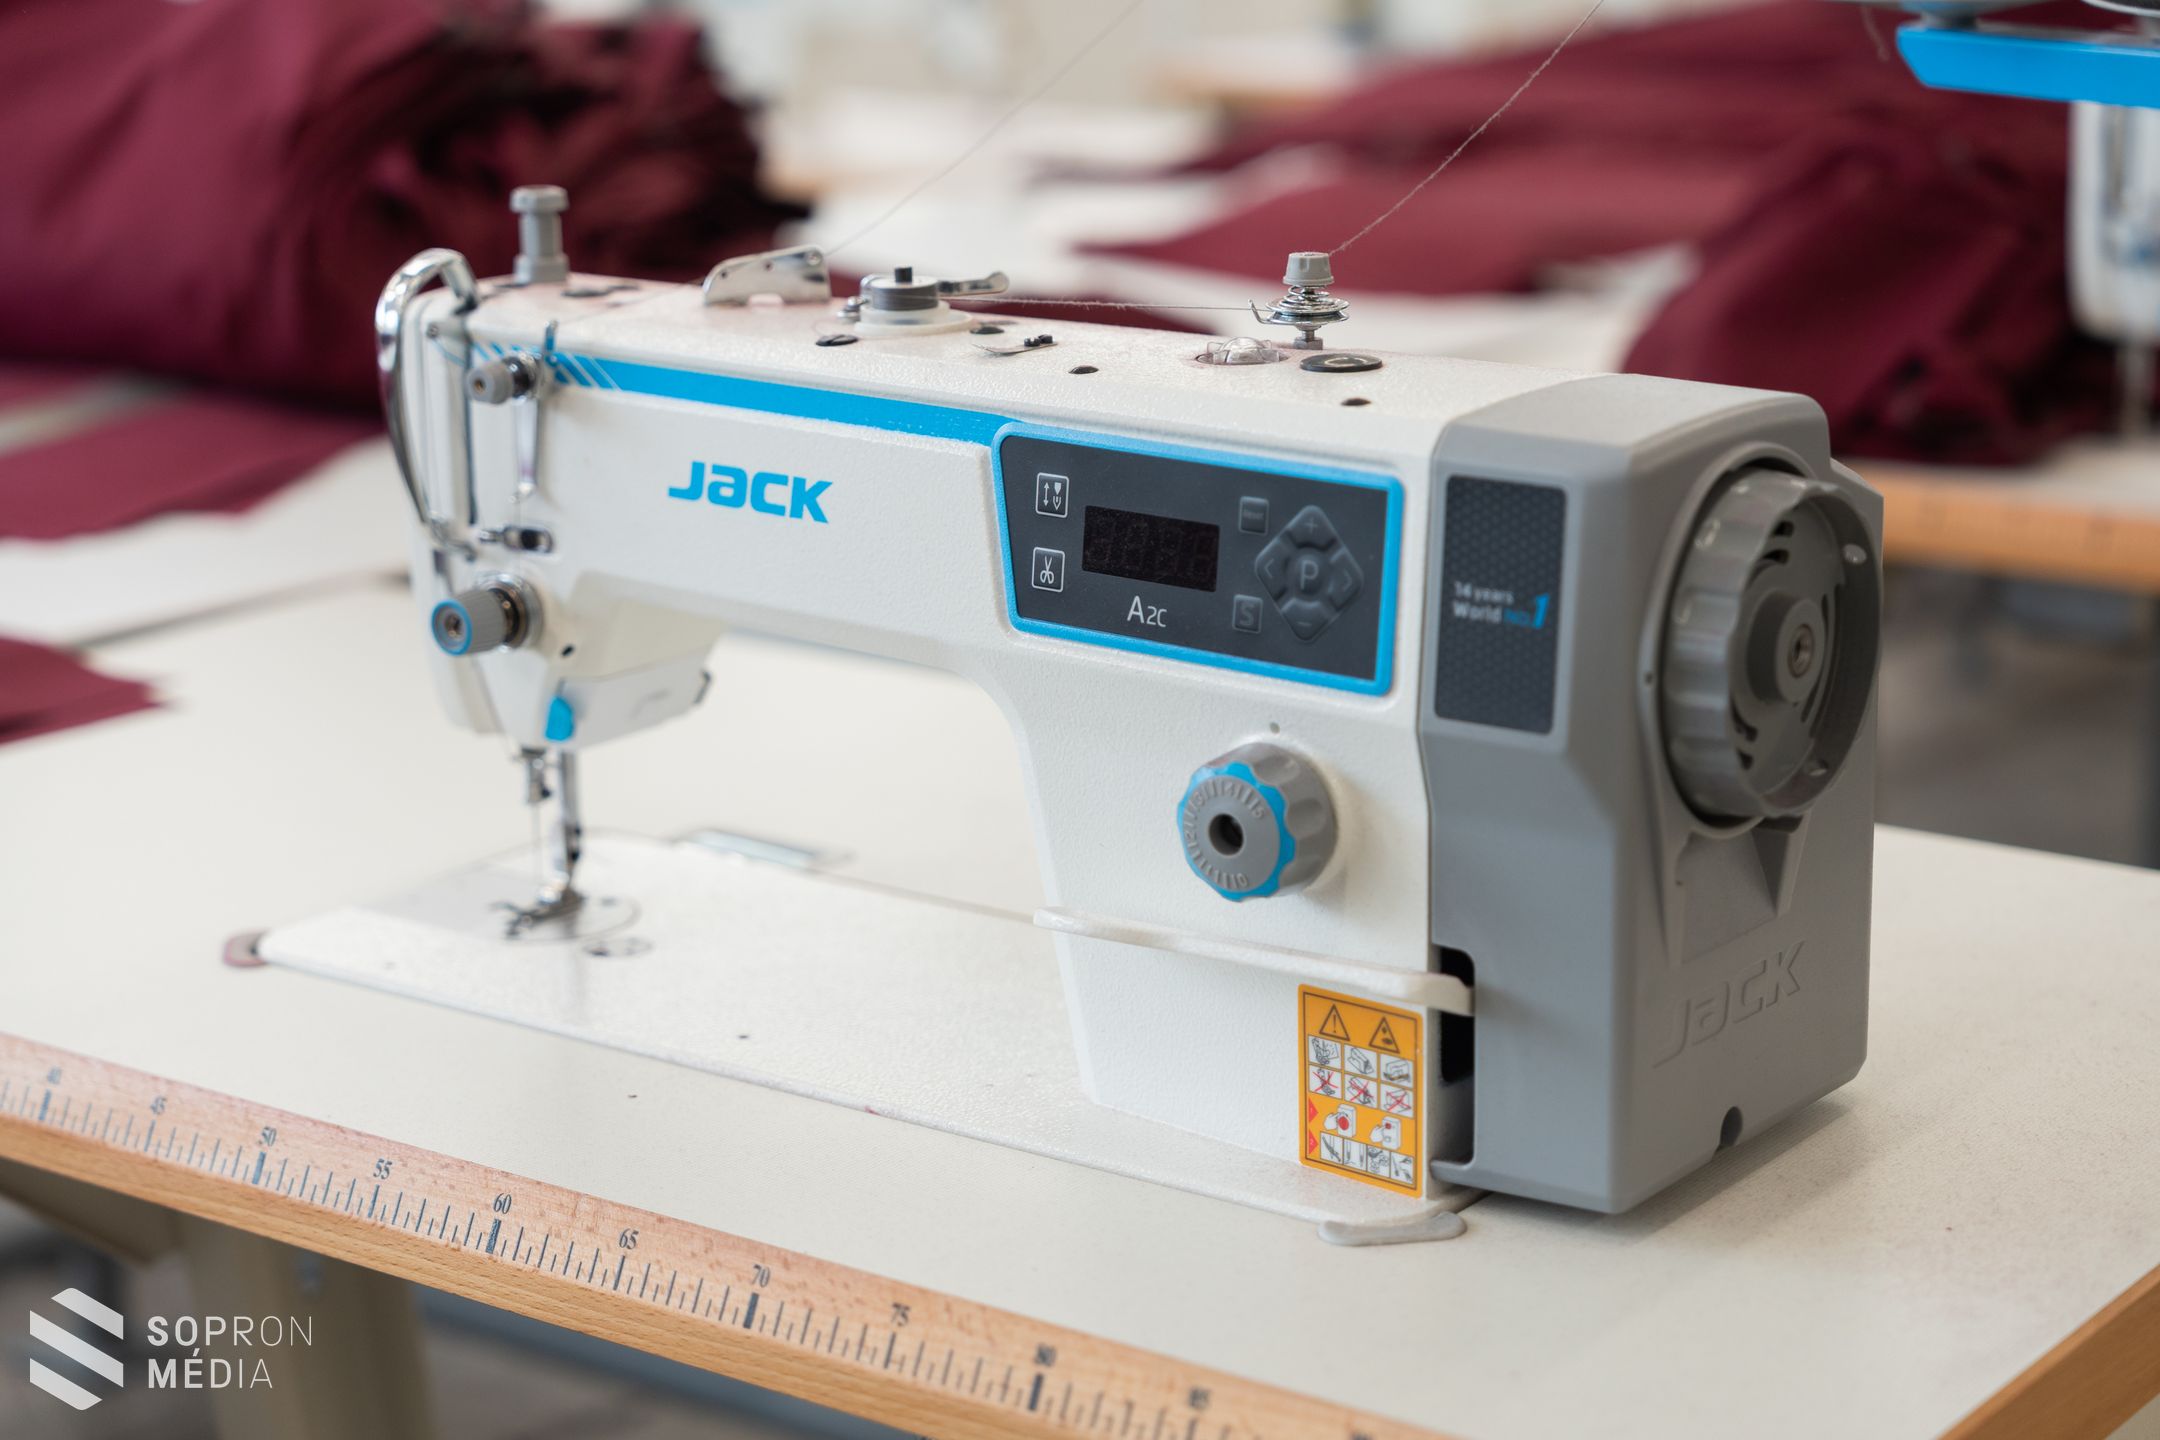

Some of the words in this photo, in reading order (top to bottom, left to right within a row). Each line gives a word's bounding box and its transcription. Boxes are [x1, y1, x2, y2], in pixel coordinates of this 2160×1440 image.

[1300, 560, 1319, 590] P
[1127, 596, 1167, 628] A2C
[1239, 603, 1255, 626] S
[1452, 600, 1503, 624] World
[259, 1126, 277, 1147] 50
[373, 1158, 393, 1180] 55
[493, 1193, 512, 1215] 60
[618, 1228, 640, 1250] 65
[753, 1264, 771, 1288] 70
[892, 1302, 911, 1327] 75
